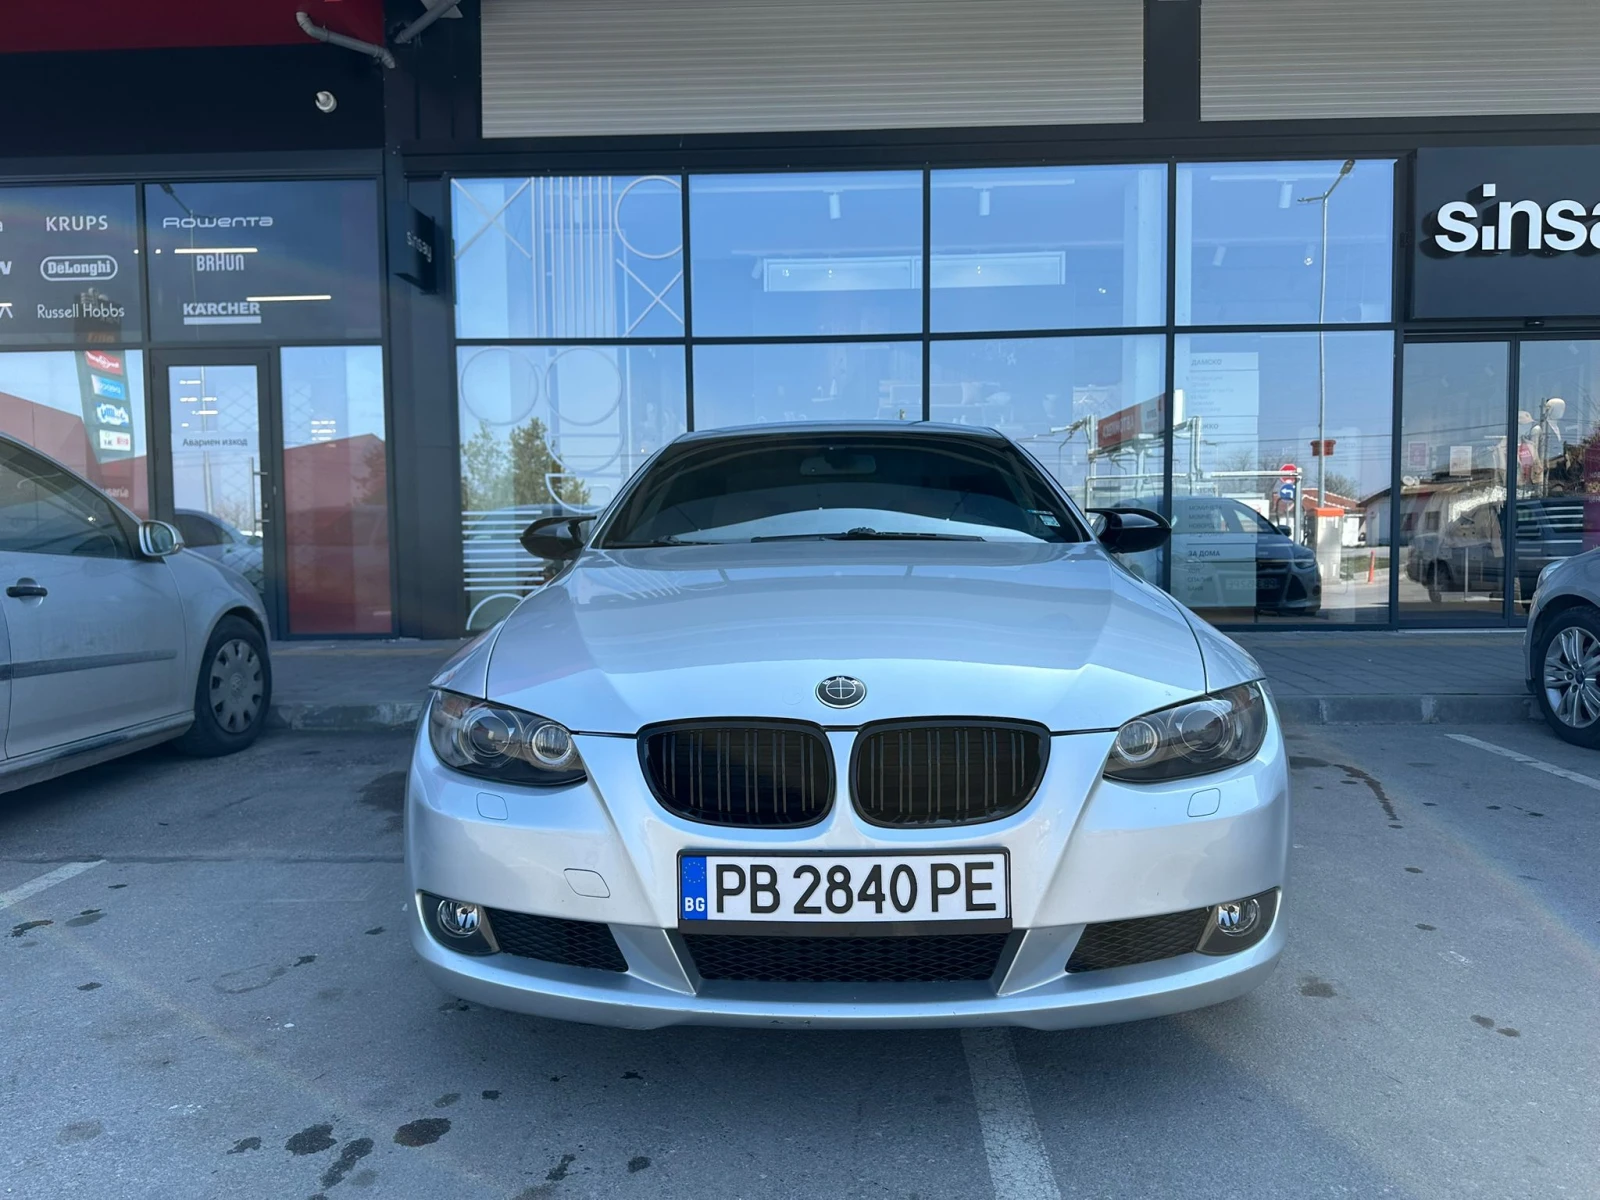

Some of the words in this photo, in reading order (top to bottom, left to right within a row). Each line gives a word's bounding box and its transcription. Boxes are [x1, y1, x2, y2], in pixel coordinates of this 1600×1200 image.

[46, 215, 108, 231] KRUPS
[1435, 184, 1600, 252] sins
[196, 251, 245, 271] BRAUN
[37, 303, 79, 318] Russell
[83, 303, 125, 318] Hobbs
[183, 438, 220, 448] Авариен
[715, 864, 781, 914] PB
[793, 864, 918, 914] 2840
[930, 861, 997, 912] PE
[684, 897, 706, 912] BG
